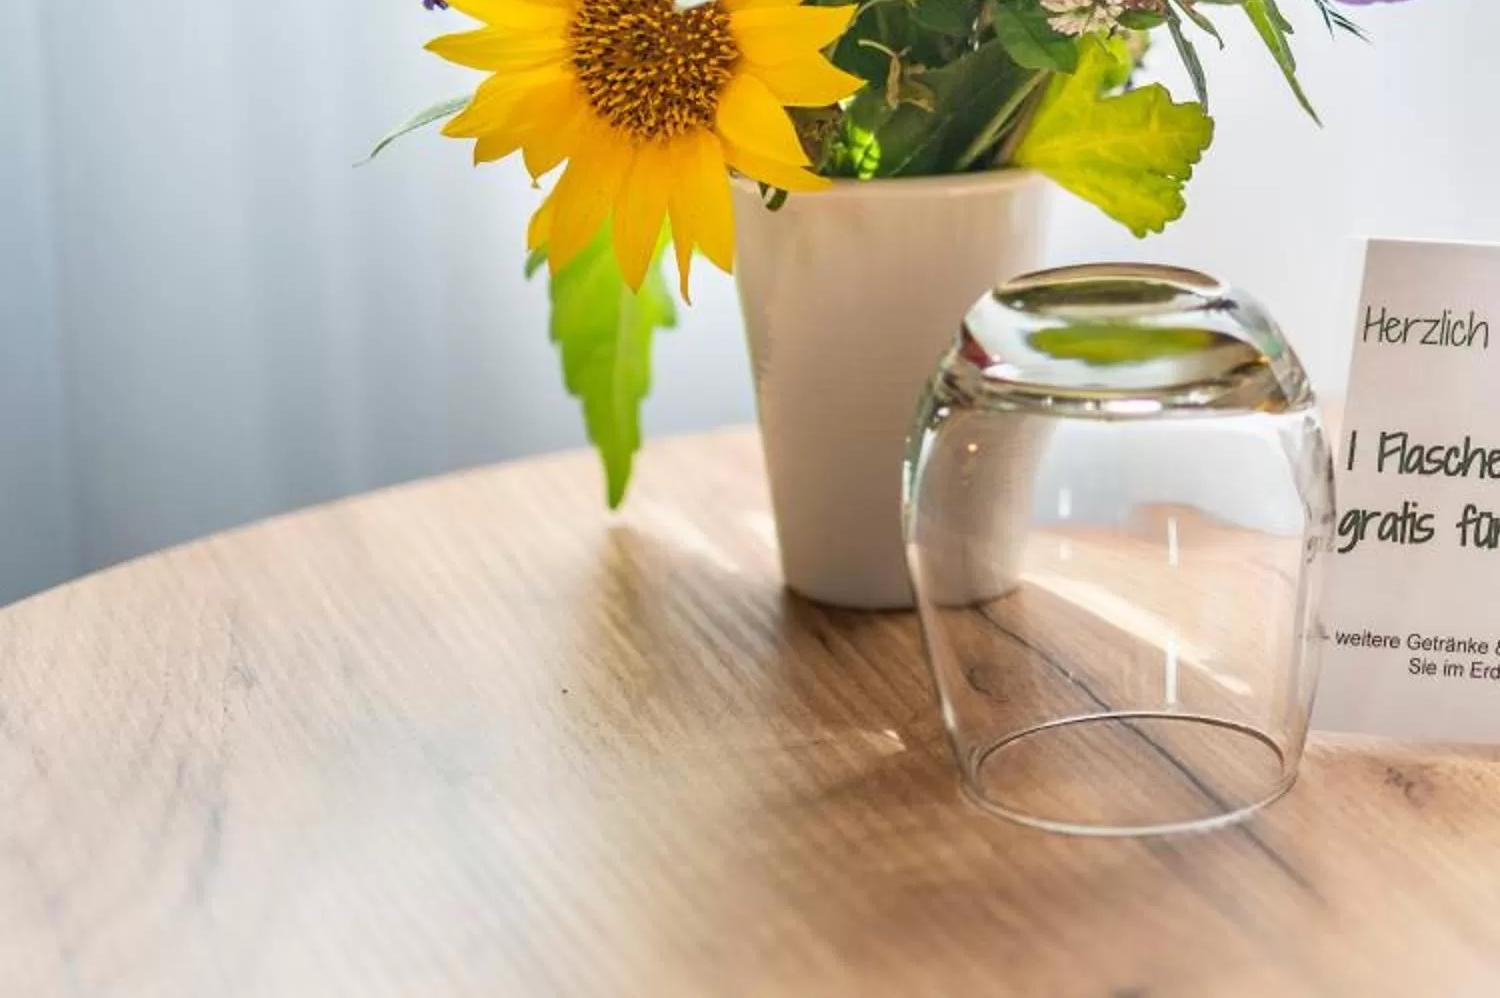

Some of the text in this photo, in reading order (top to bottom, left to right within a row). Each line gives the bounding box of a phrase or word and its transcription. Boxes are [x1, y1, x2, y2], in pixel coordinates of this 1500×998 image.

[1363, 305, 1489, 349] Herzlich
[1337, 502, 1435, 553] gratis
[1335, 630, 1400, 649] weitere
[1406, 633, 1489, 655] Getränke
[1408, 657, 1437, 675] Sie
[1443, 659, 1464, 677] im
